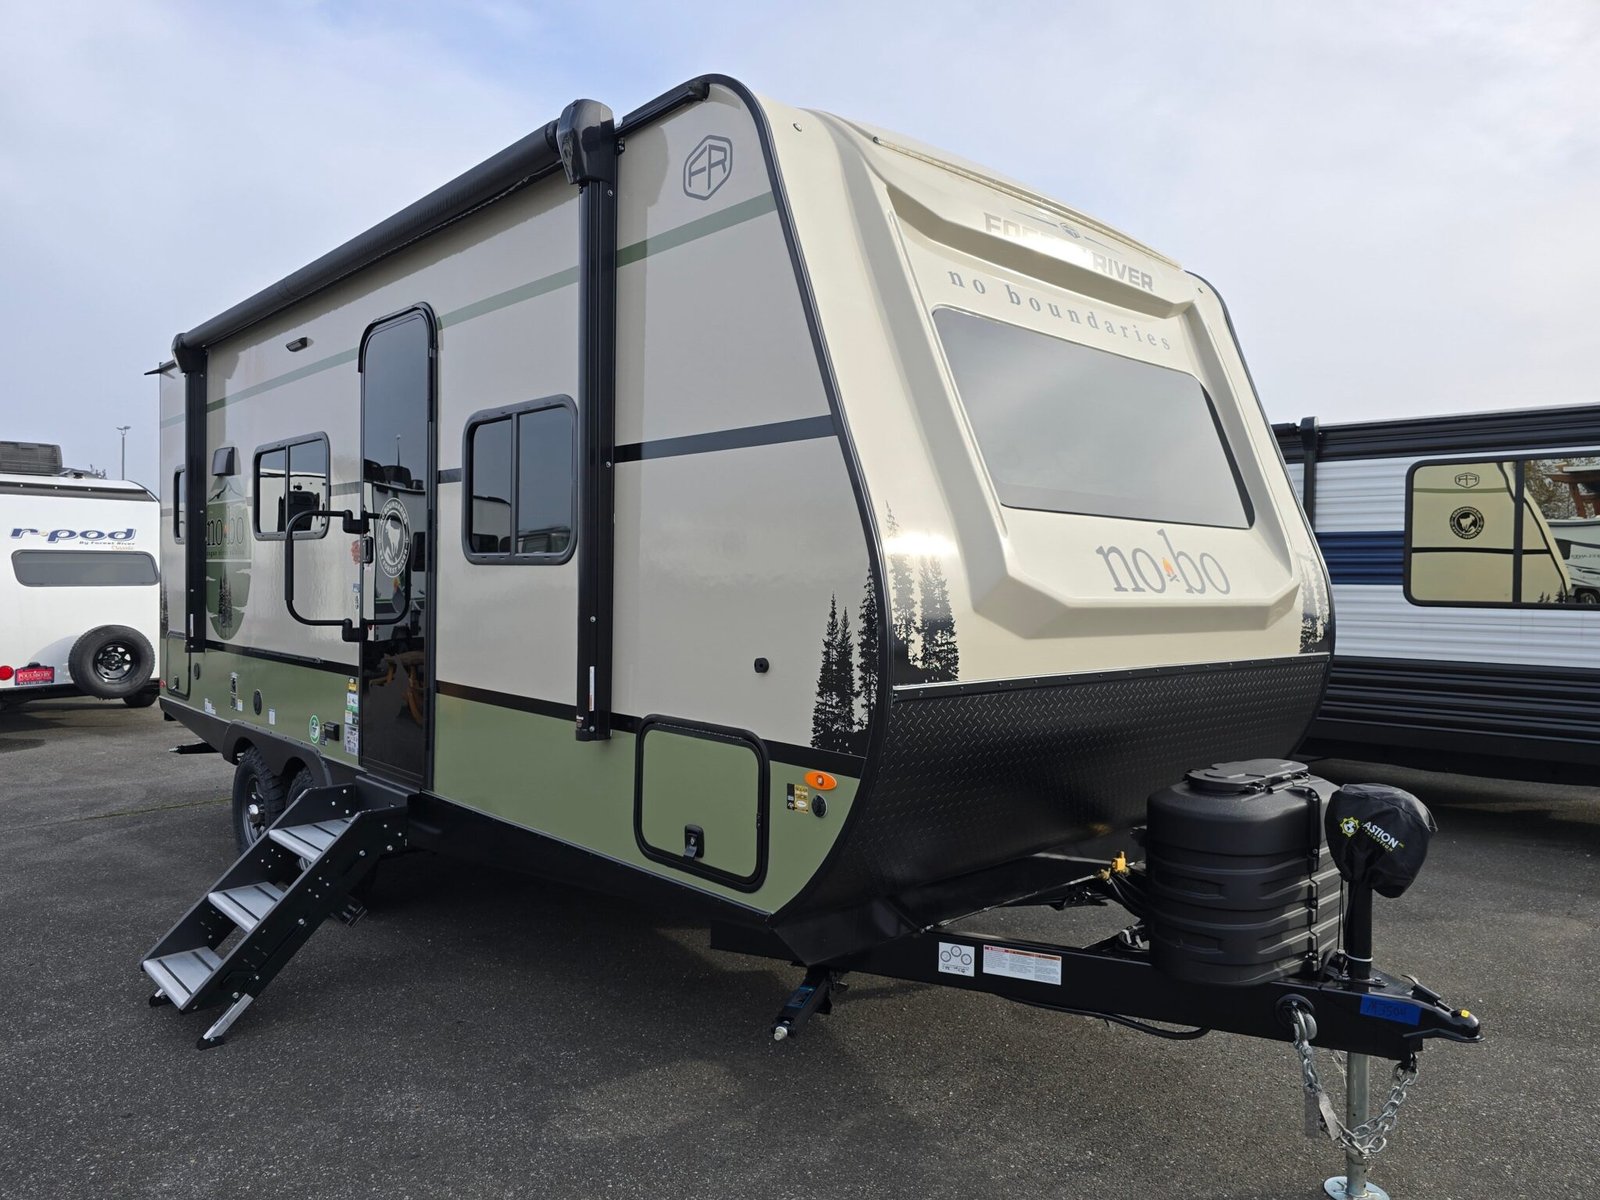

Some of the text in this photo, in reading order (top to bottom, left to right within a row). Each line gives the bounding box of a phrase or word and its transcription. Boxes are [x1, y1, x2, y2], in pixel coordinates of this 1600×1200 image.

[1093, 252, 1154, 292] RIVER
[947, 269, 1170, 351] no boundaries
